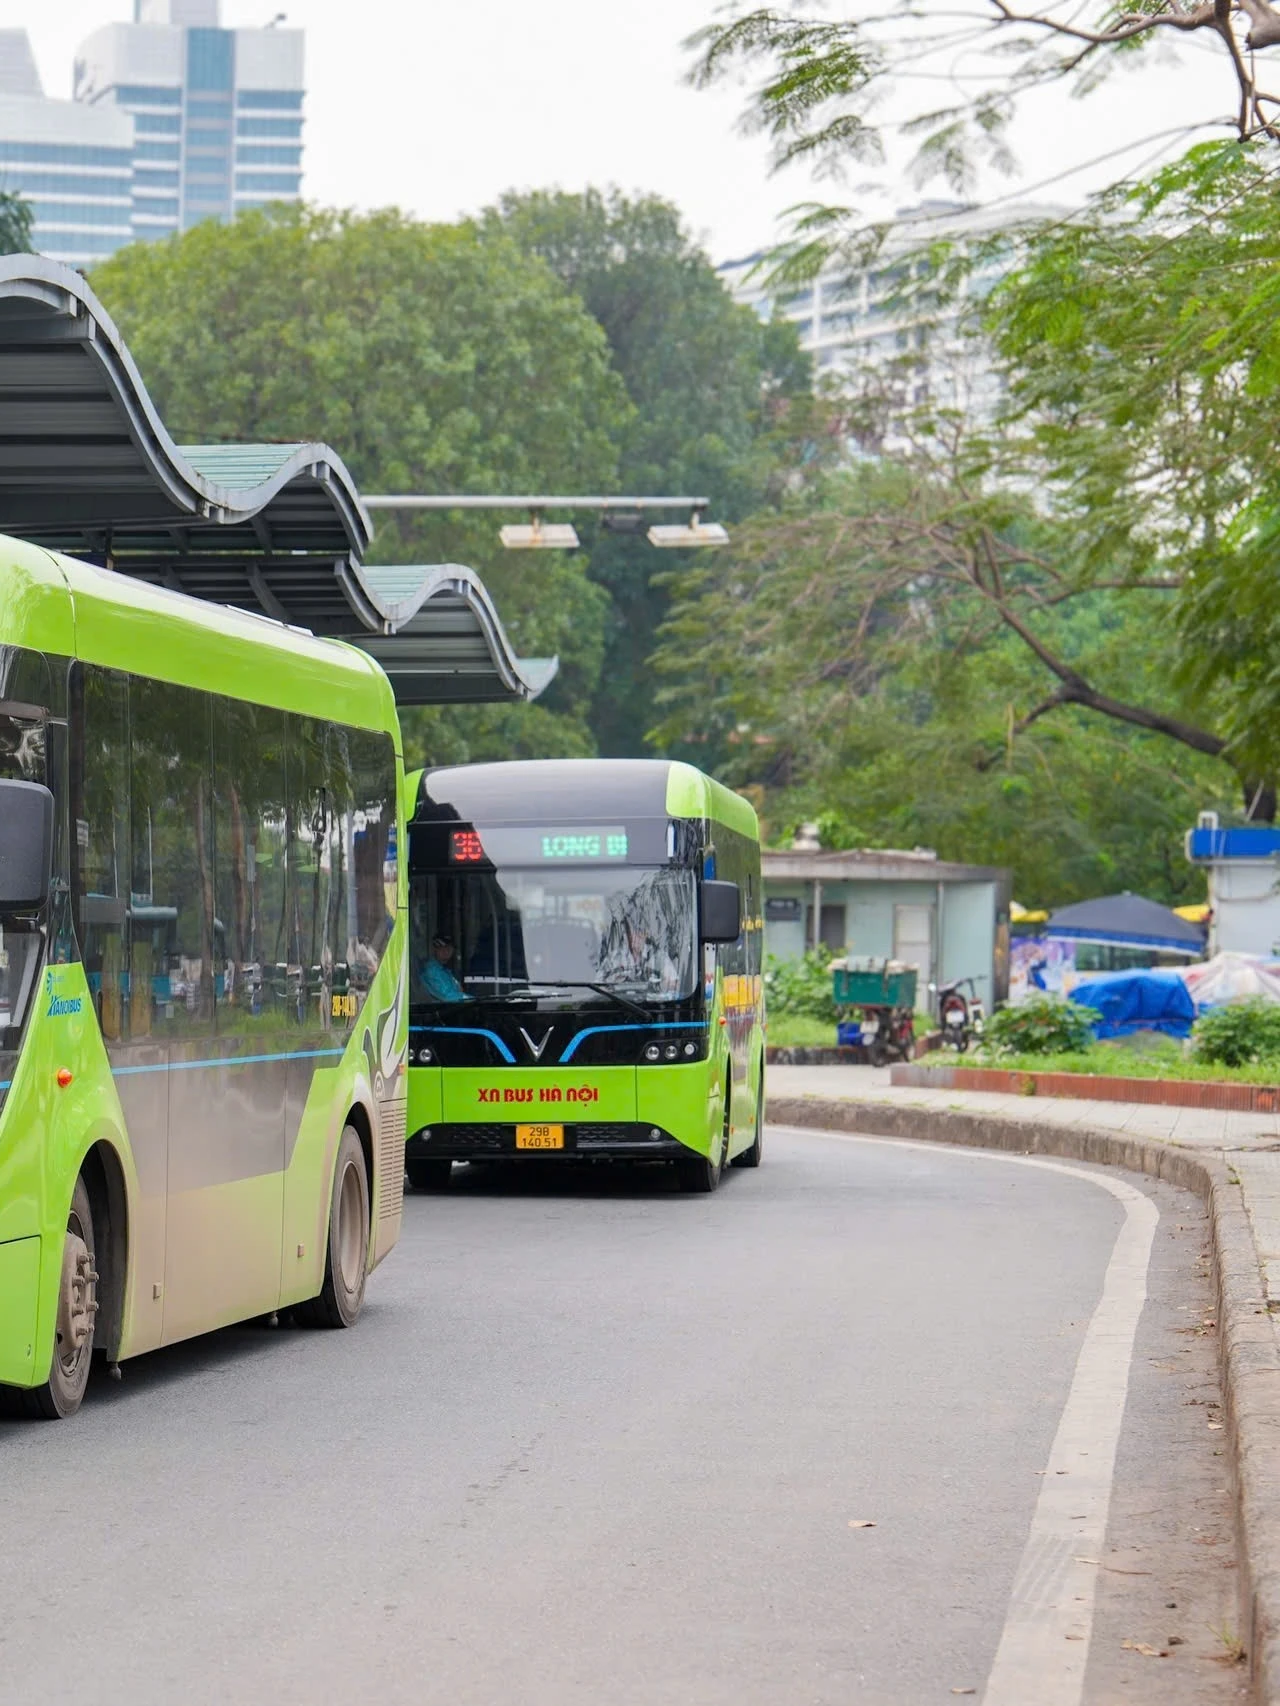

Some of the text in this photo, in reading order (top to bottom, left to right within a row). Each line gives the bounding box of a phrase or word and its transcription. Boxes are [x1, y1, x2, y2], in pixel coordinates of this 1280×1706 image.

[541, 835, 601, 857] LONG
[478, 1084, 599, 1107] XN BUS HÀ NỘI
[529, 1127, 550, 1137] 29B
[522, 1138, 557, 1148] 140.51
